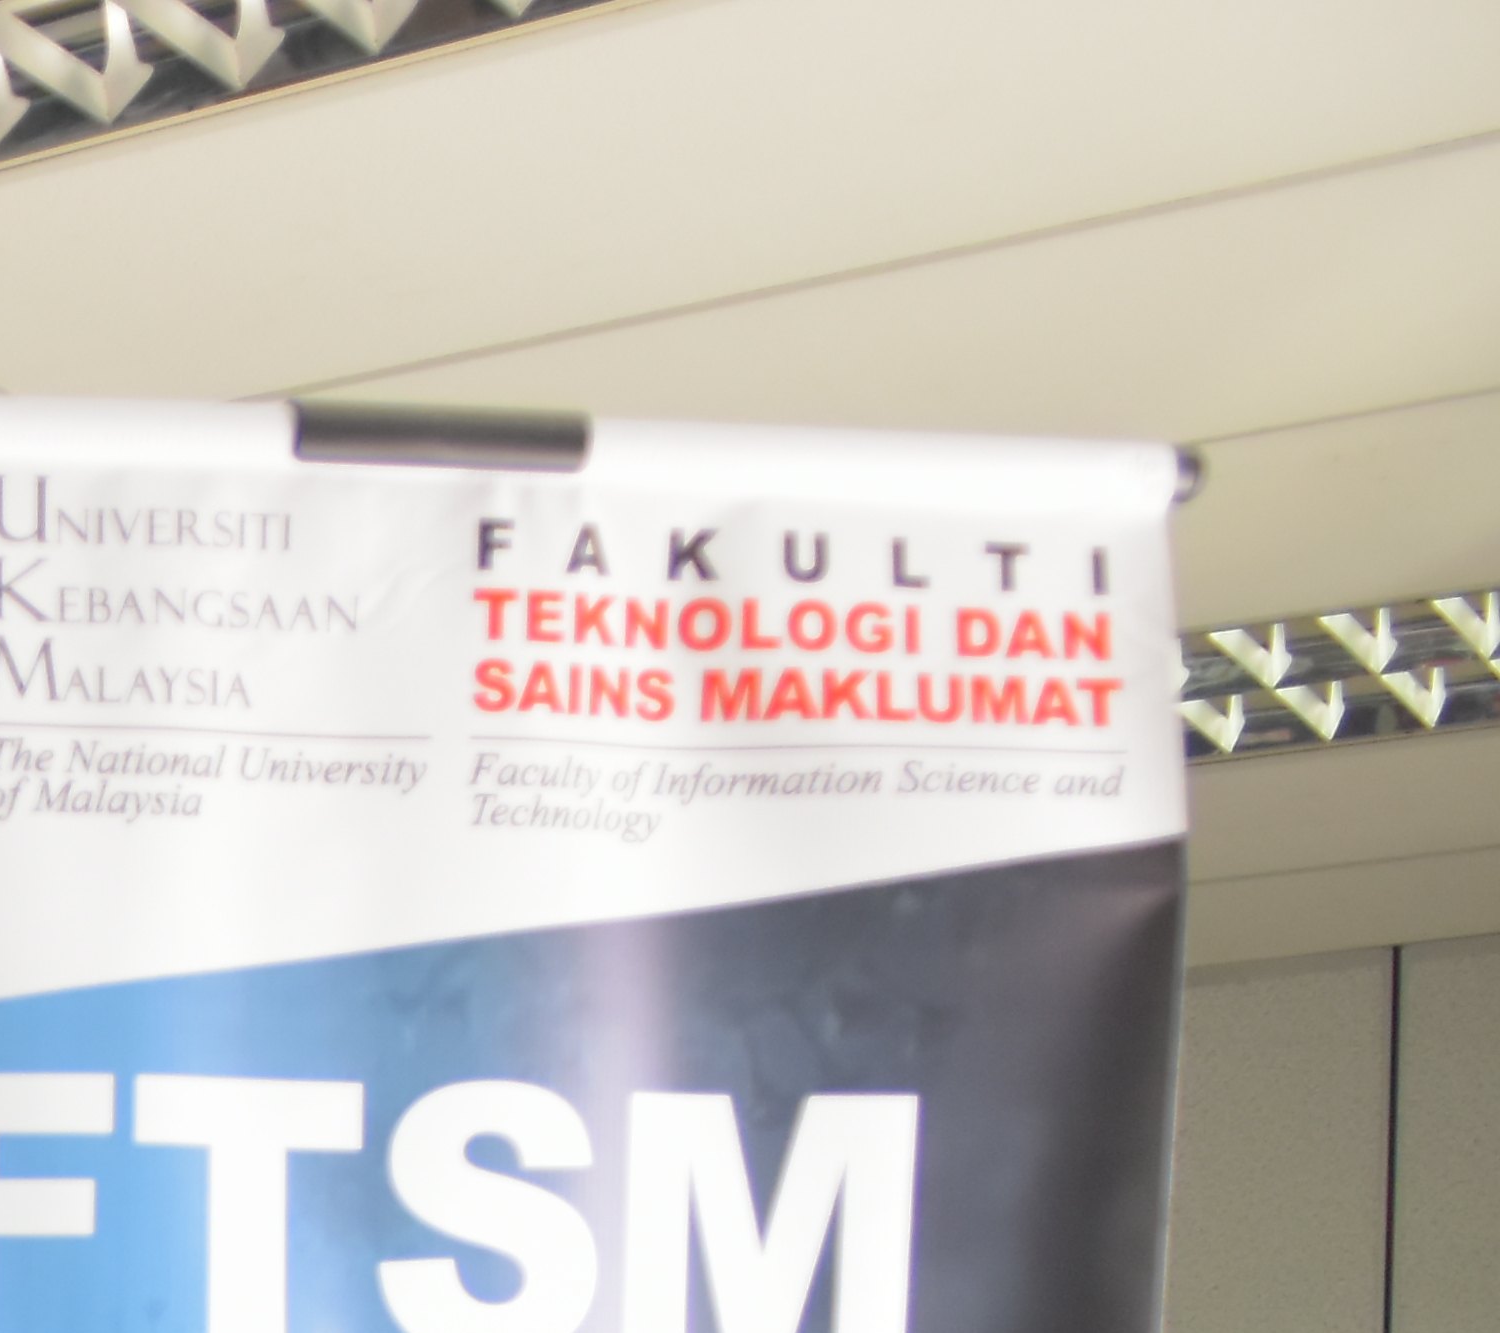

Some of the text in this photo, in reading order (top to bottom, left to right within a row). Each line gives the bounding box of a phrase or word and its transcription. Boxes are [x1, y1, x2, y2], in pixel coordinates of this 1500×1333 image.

[473, 587, 1112, 661] TEKNOLOGI DAN
[473, 658, 1124, 728] SAINS MAKLUMAT
[66, 739, 227, 780] National
[240, 745, 428, 795] University
[469, 751, 1125, 807] Faculty of Information Science and
[34, 778, 204, 823] Malaysia
[471, 797, 661, 844] Technology
